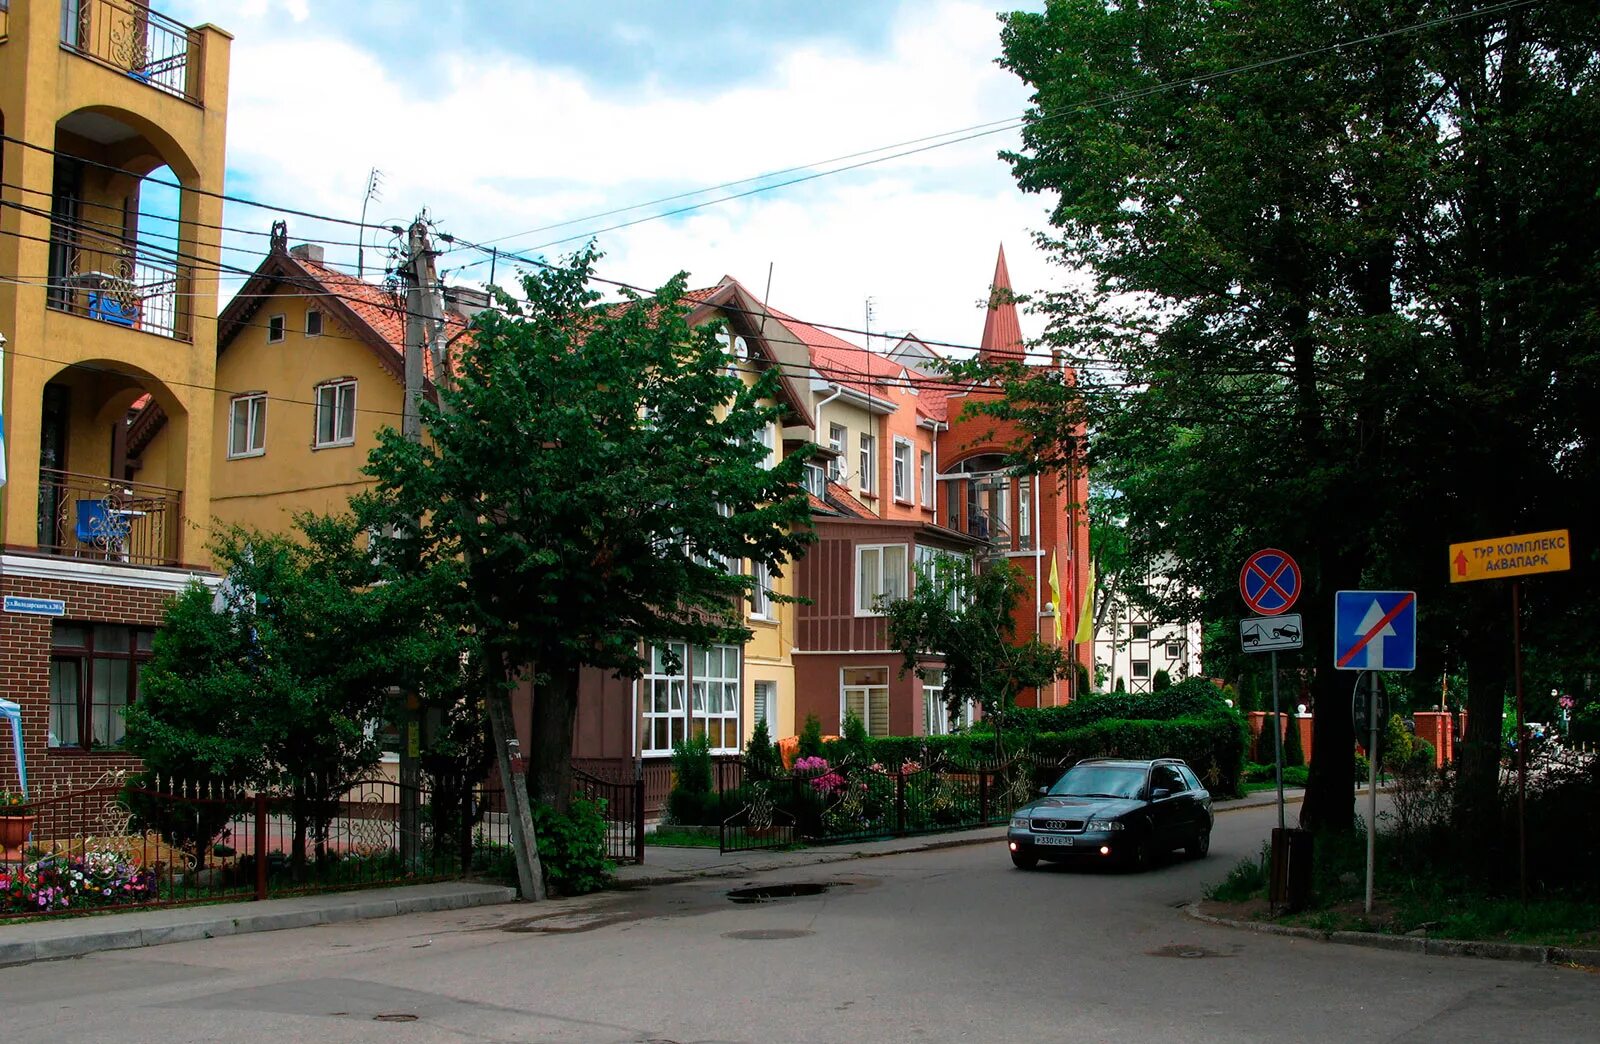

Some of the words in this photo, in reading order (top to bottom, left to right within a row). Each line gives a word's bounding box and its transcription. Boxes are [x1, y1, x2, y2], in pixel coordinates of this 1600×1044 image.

[1473, 546, 1494, 559] ТУР
[1497, 537, 1566, 555] КОМПЛЕКС
[1486, 553, 1549, 571] АКВАПАРК
